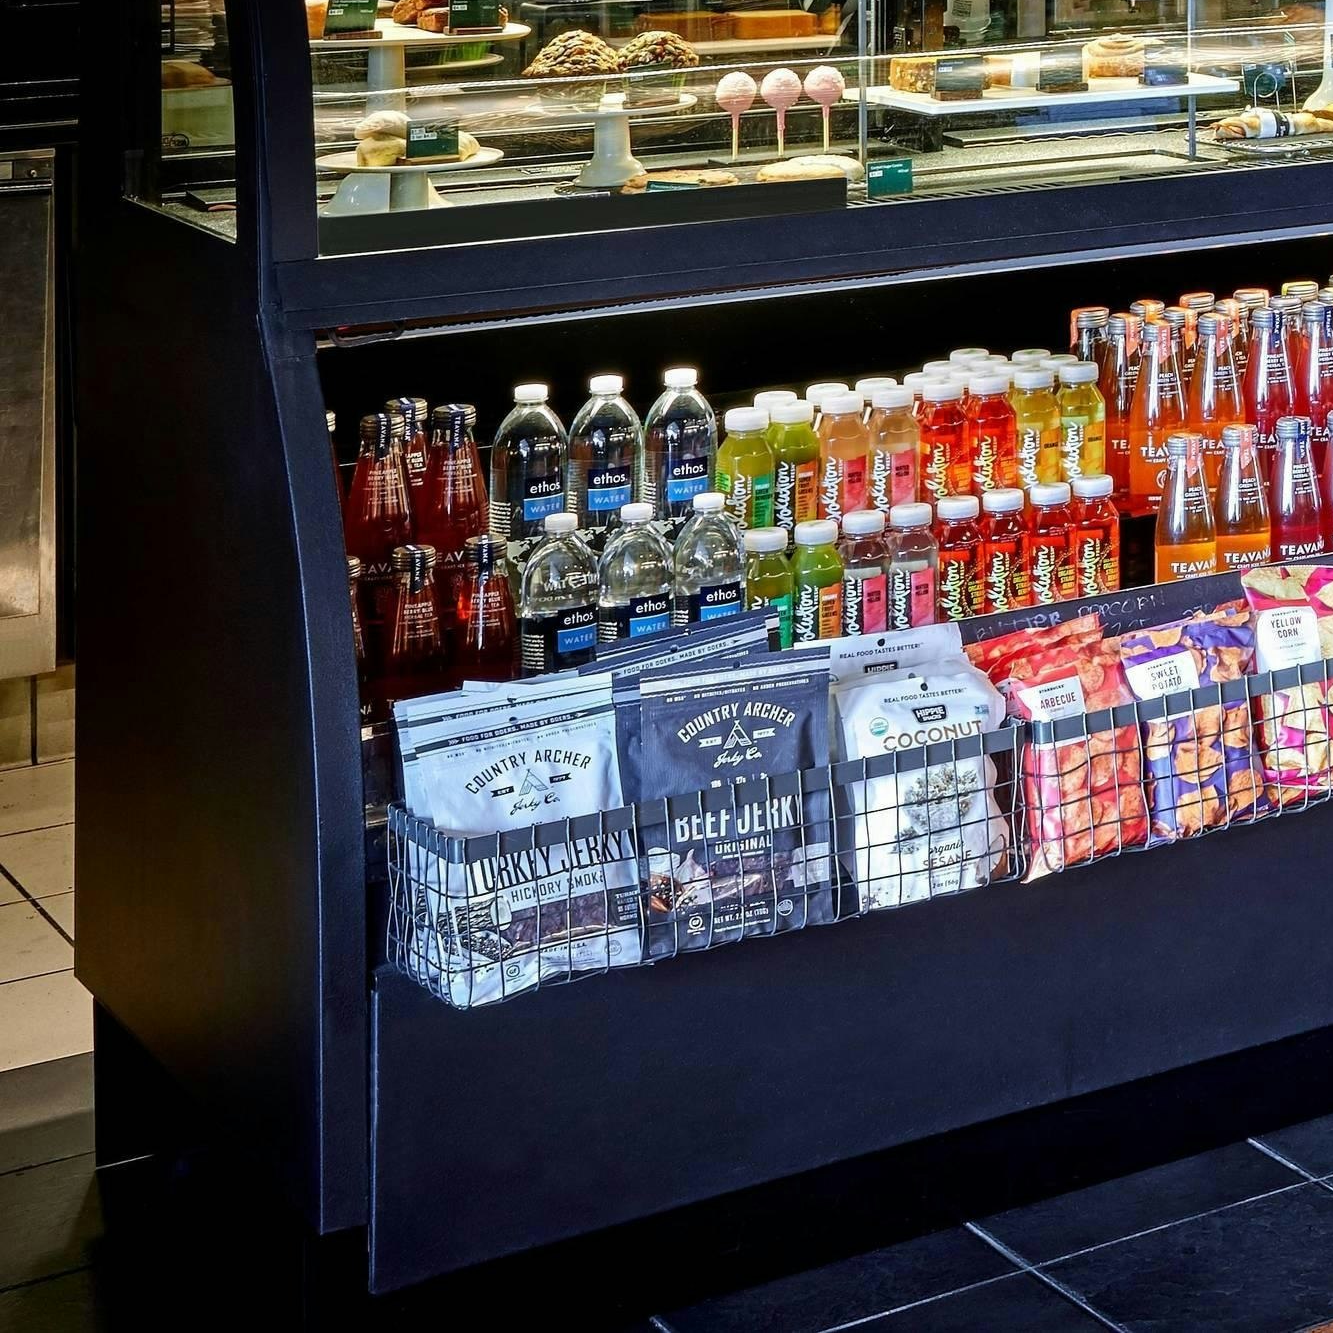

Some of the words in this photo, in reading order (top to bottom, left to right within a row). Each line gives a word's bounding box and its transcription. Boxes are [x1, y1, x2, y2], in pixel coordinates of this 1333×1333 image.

[594, 473, 626, 485] ethos
[594, 495, 624, 504] WATER
[564, 612, 593, 625] ethos
[1270, 616, 1302, 629] YELLOW
[1278, 626, 1298, 638] CORN
[564, 634, 593, 644] WATER
[920, 691, 939, 699] TASTES
[916, 707, 944, 717] HIPPIE
[677, 702, 740, 744] COUNTRY
[743, 702, 796, 727] ARCHER
[883, 721, 982, 752] COCONUT
[465, 752, 527, 795] COUNTRY
[535, 749, 592, 770] ARCHER
[510, 798, 541, 816] Jerky
